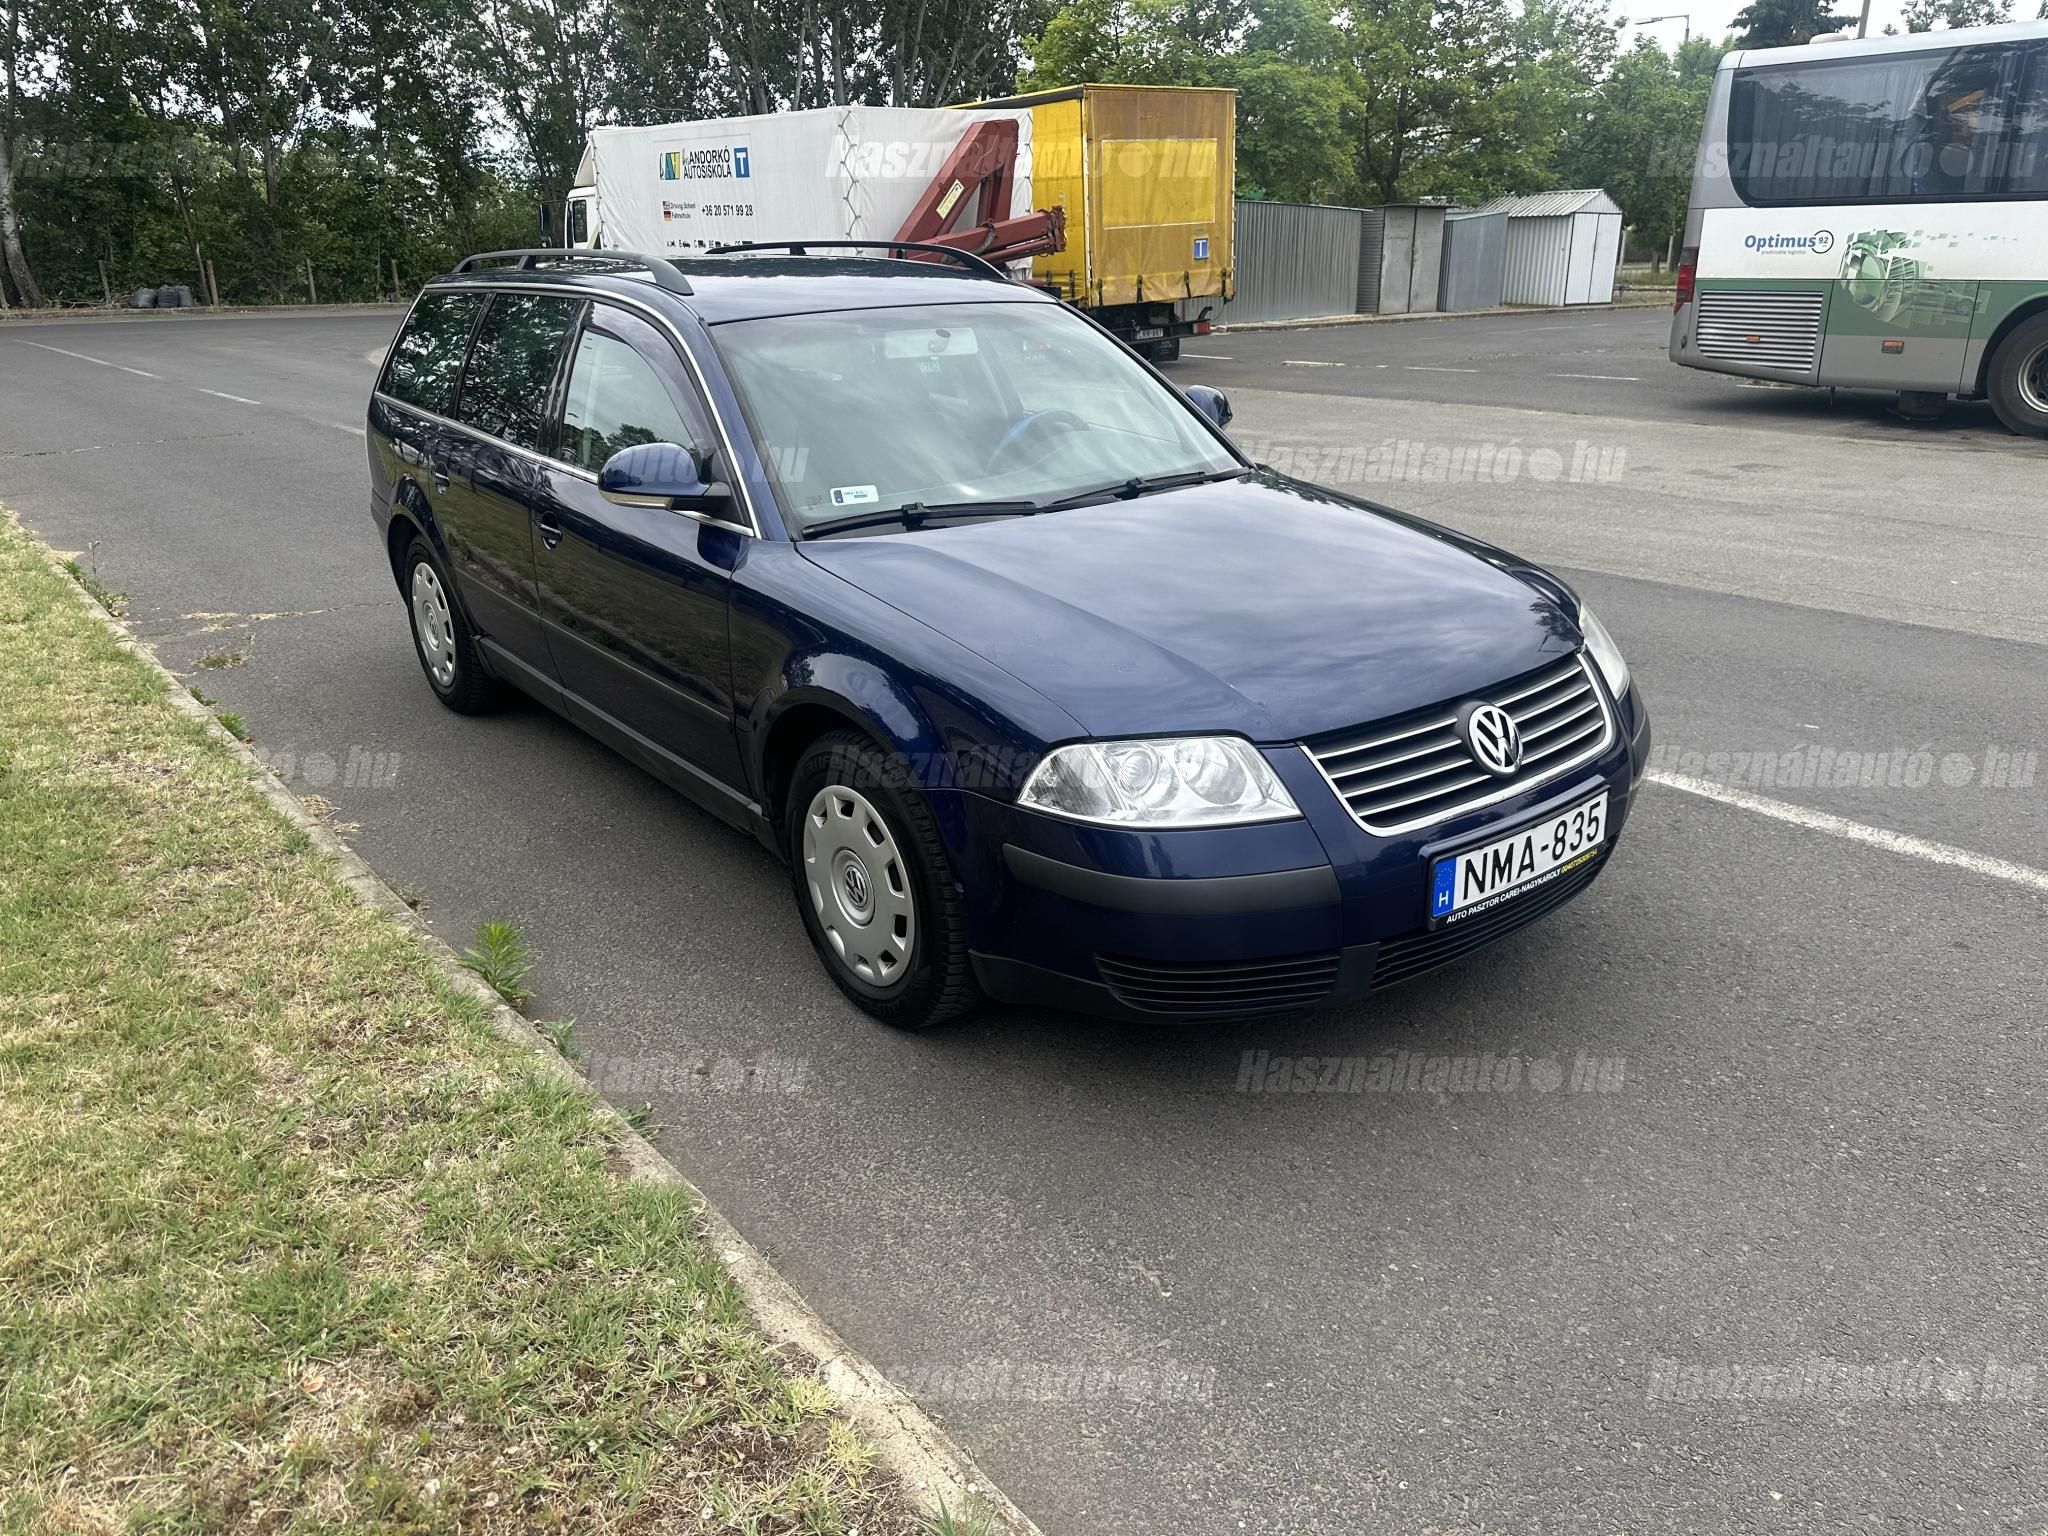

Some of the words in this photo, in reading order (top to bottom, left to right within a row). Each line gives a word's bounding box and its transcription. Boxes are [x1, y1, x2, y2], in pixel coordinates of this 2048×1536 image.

[701, 205, 713, 216] +36
[714, 204, 721, 216] 20
[723, 204, 734, 216] 571
[736, 204, 744, 216] 99
[745, 204, 754, 216] 28
[1744, 233, 1817, 253] Optimus
[1818, 236, 1829, 244] 92
[1463, 800, 1601, 900] NMA-835
[1437, 890, 1450, 908] H
[1446, 909, 1468, 924] AUTO
[1467, 896, 1500, 917] PASZTOR
